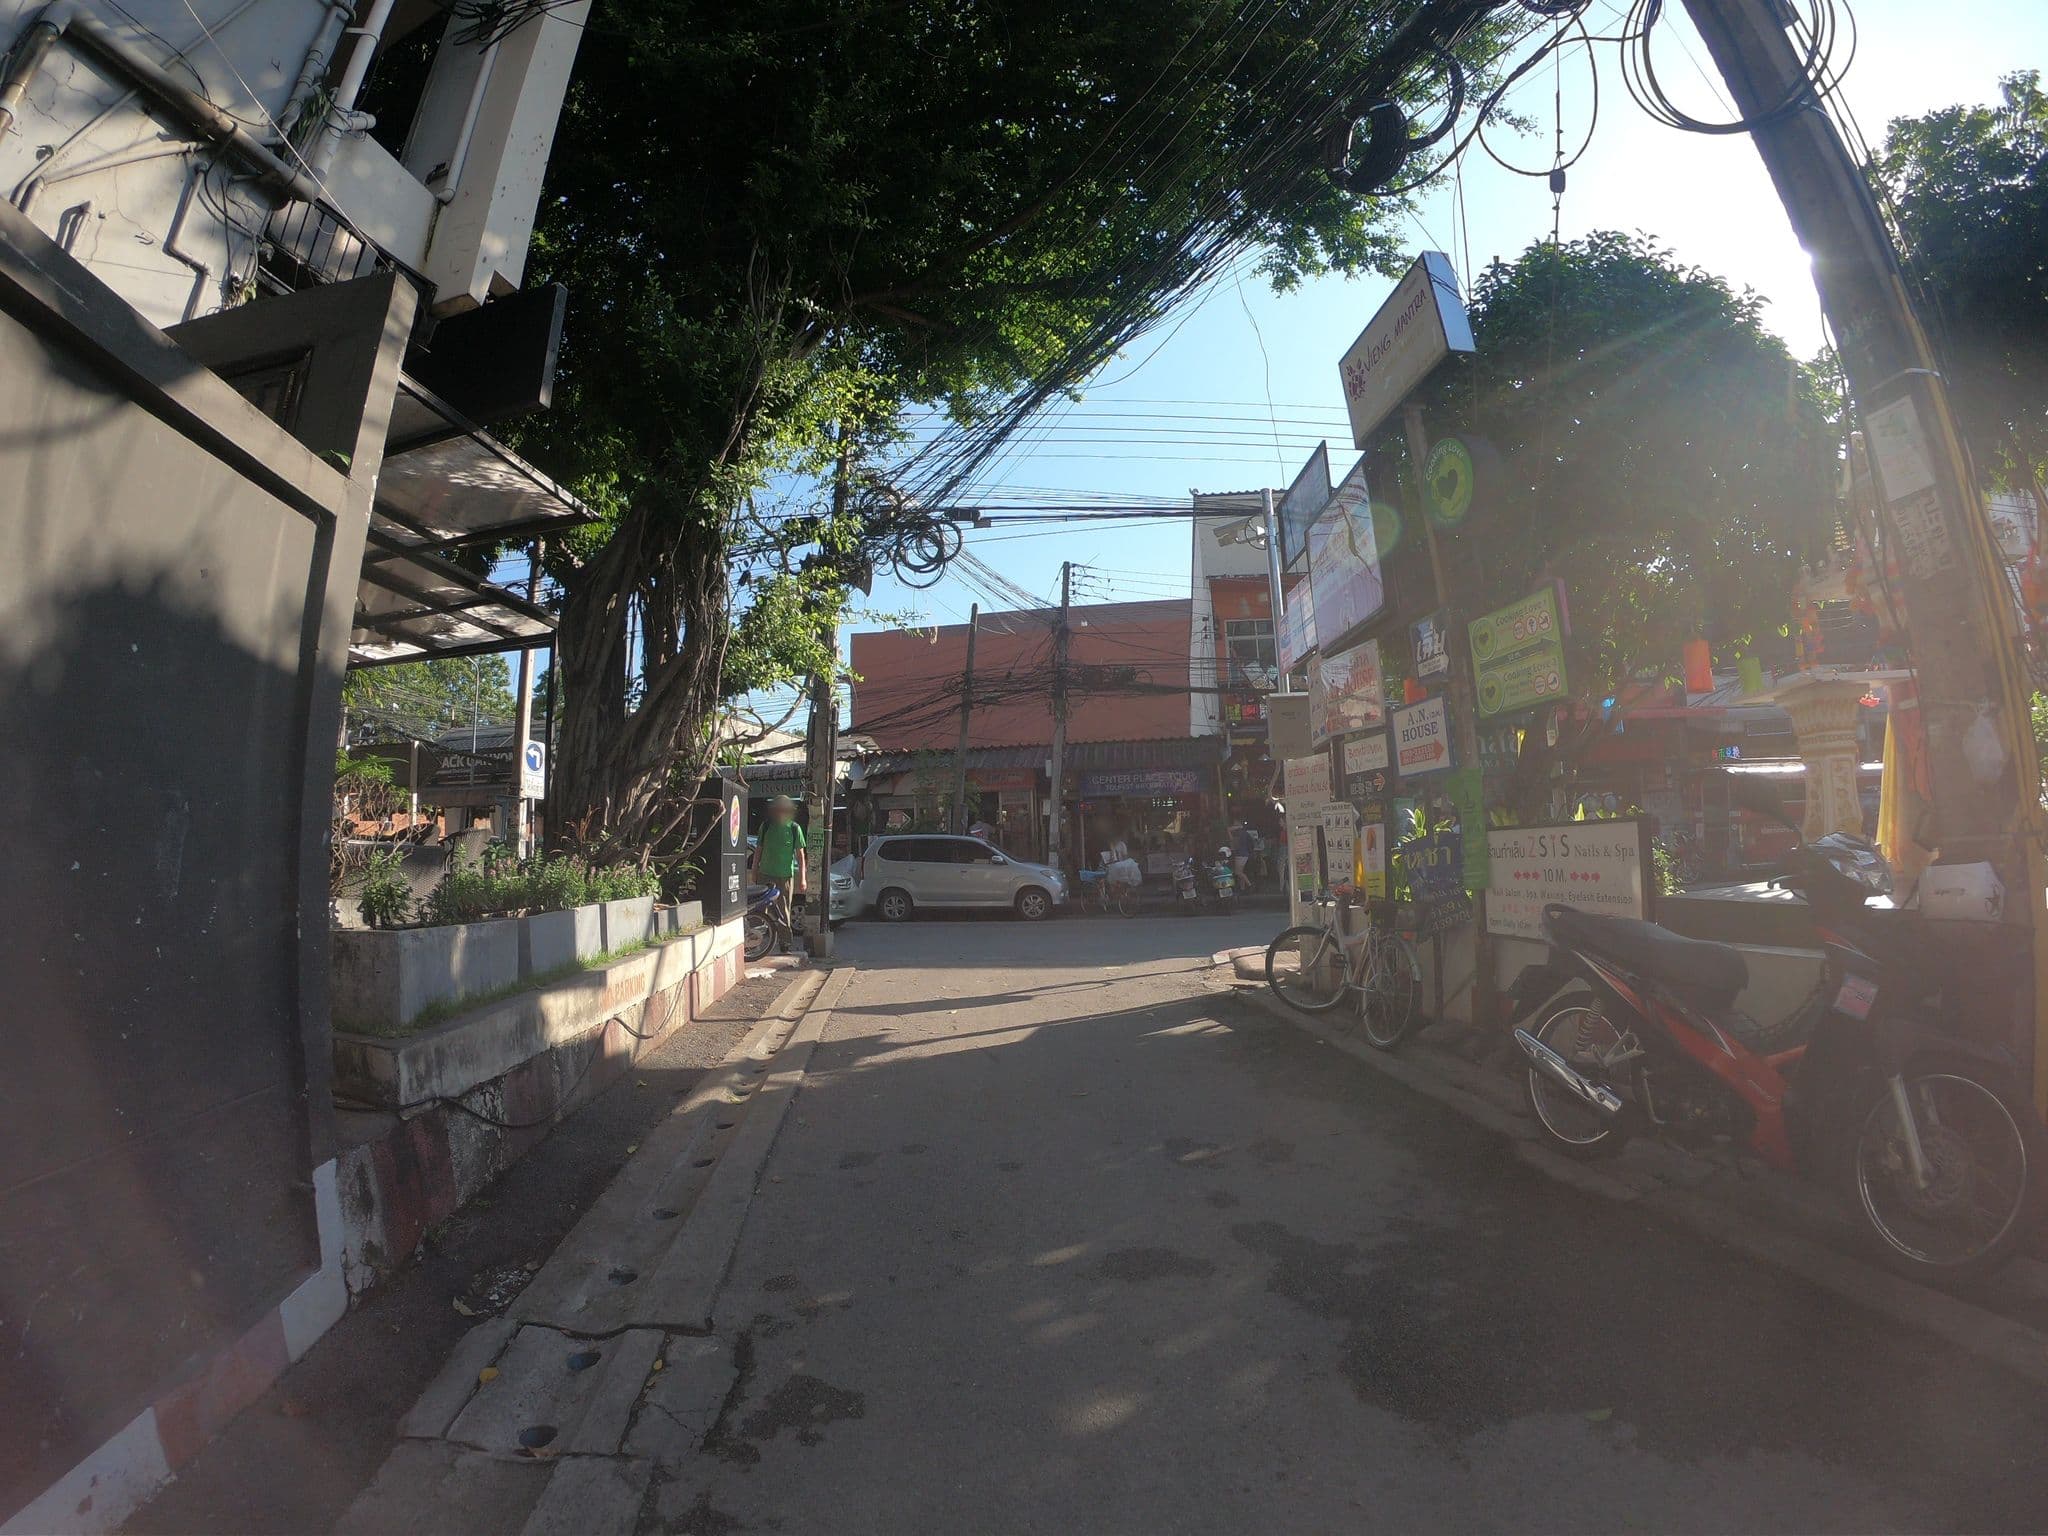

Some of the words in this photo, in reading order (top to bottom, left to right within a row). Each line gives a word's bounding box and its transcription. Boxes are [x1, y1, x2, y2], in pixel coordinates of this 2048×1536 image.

[1364, 333, 1391, 372] VIENG
[1393, 288, 1427, 337] MANTRA
[1402, 722, 1439, 742] HOUSE
[1574, 844, 1601, 857] Nails
[1603, 846, 1611, 857] &
[1543, 868, 1554, 883] 10
[1568, 891, 1595, 903] Eyelash
[1596, 893, 1633, 905] Extension
[614, 972, 646, 1003] PARKING
